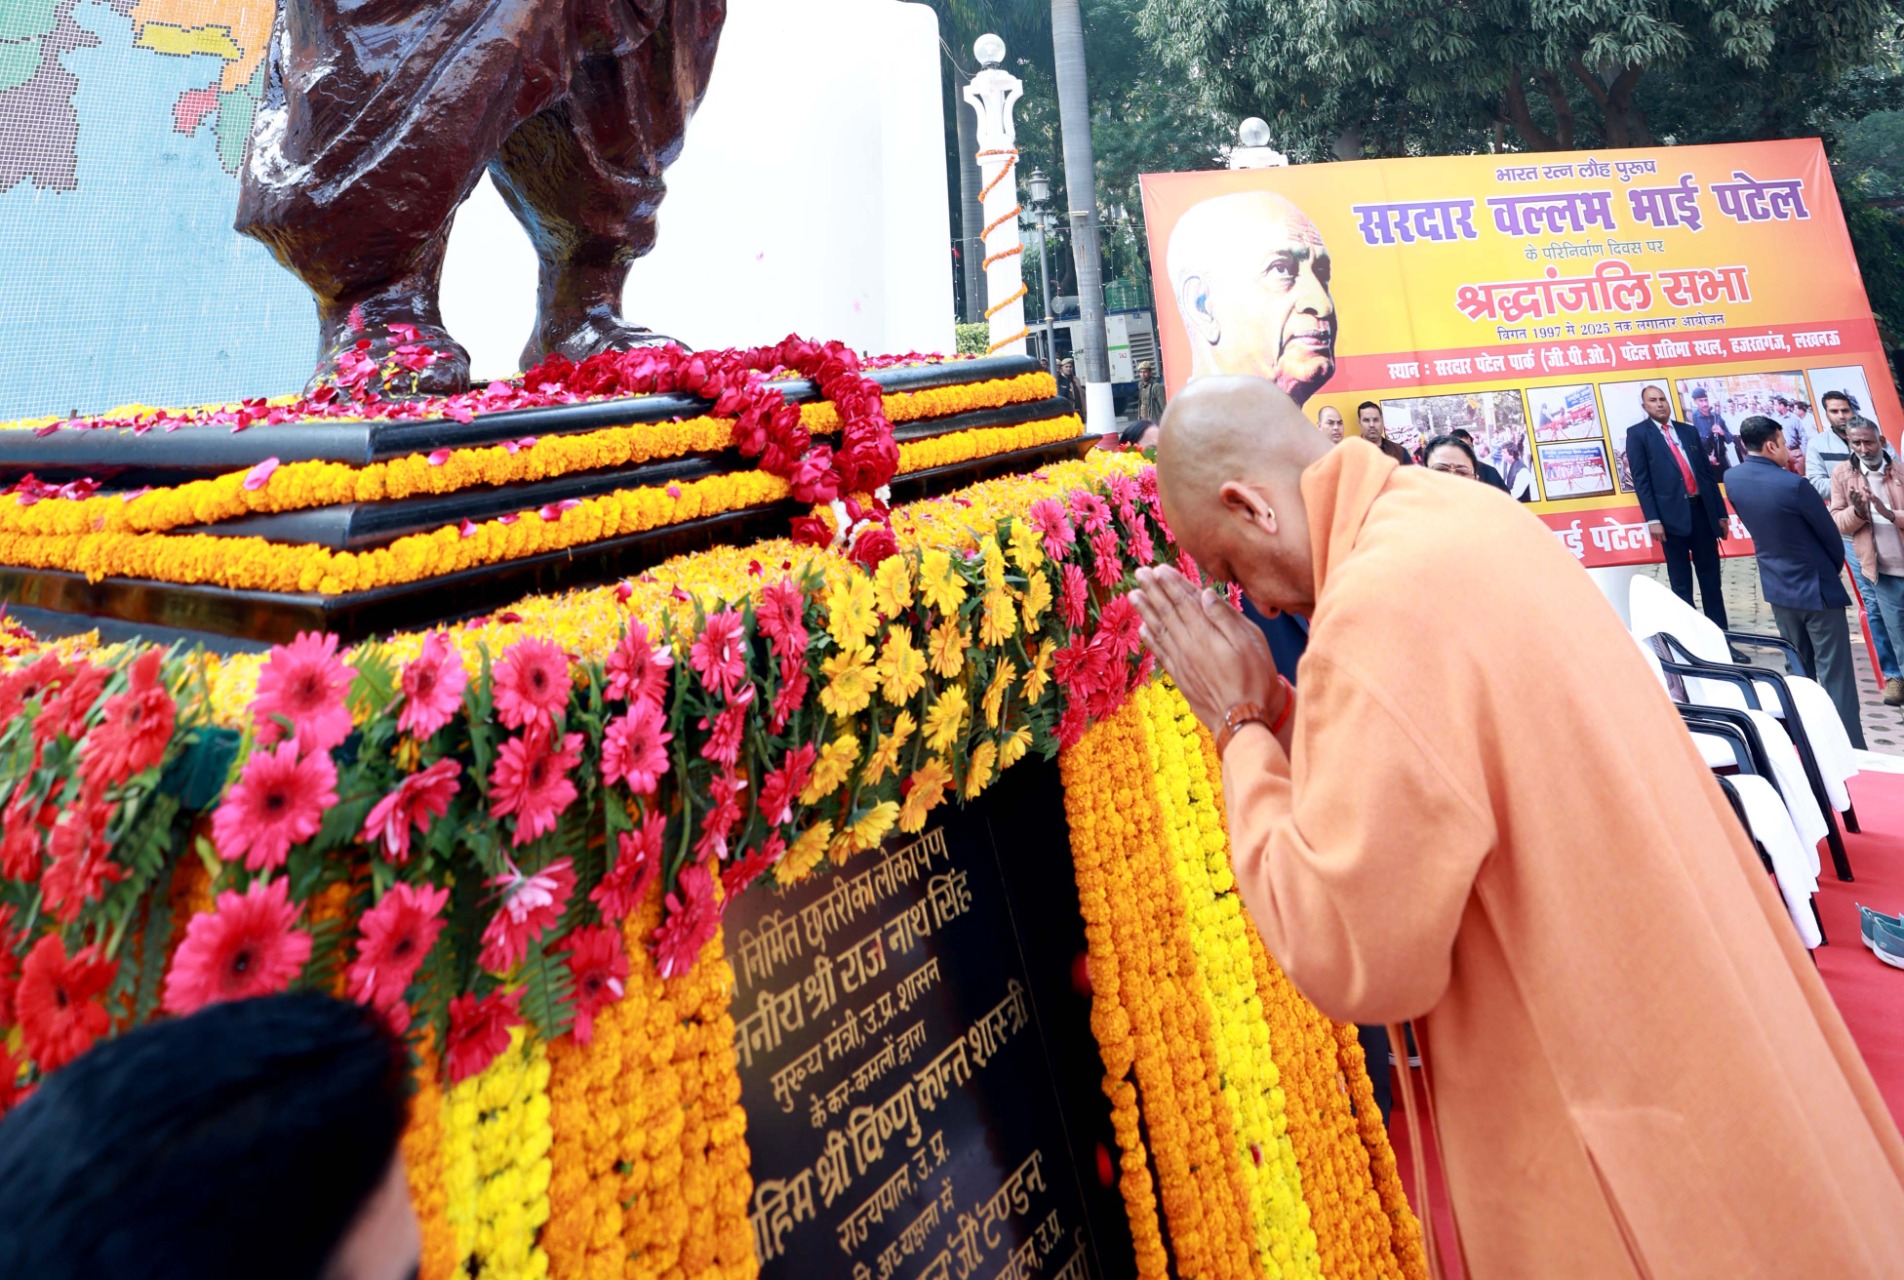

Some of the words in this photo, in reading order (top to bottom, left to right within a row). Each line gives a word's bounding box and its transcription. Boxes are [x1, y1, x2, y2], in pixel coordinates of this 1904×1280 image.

[1496, 167, 1538, 181] भारत
[1543, 164, 1573, 179] रत्न
[1578, 158, 1611, 178] लौह
[1353, 200, 1478, 244] सरदार
[1487, 191, 1616, 235] वल्लभ
[1628, 175, 1702, 232] भाई
[1711, 173, 1809, 222] पटेल
[1524, 244, 1538, 260] के
[1541, 239, 1604, 260] परिनिर्वाण
[1606, 239, 1642, 256] दिवस
[1645, 240, 1665, 253] पर
[1457, 260, 1651, 322] श्रद्धांजलि
[1659, 267, 1751, 307] सभा
[1386, 361, 1421, 380] स्थान
[1433, 357, 1472, 376] सरदार
[1474, 352, 1506, 373] पटेल
[1507, 349, 1535, 370] पार्क
[1619, 341, 1651, 362] पटेल
[1653, 338, 1691, 360] प्रतिमा
[1728, 331, 1791, 353] हजरतगंज,
[1792, 329, 1841, 349] लखनऊ
[1497, 326, 1527, 340] विगत
[1533, 326, 1561, 338] 1997
[1566, 322, 1576, 335] से
[1581, 322, 1611, 336] 2025
[1615, 320, 1633, 332] तक
[1637, 317, 1678, 329] लगातार
[1681, 311, 1725, 326] आयोजन
[1589, 516, 1653, 552] पटेल
[737, 908, 803, 990] निर्मित
[799, 875, 855, 953] छतरी
[848, 869, 877, 915] का
[872, 825, 950, 900] लोकार्पण
[803, 954, 838, 1020] श्री
[837, 927, 888, 993] राज
[884, 898, 932, 956] नाथ
[928, 867, 973, 929] सिंह
[769, 1042, 825, 1114] मुख्य
[808, 1092, 828, 1129] के
[895, 1019, 928, 1066] द्वारा
[815, 1127, 853, 1209] श्री
[845, 1081, 923, 1176] विष्णु
[912, 1034, 973, 1112] कान्त
[967, 977, 1030, 1068] शास्त्री
[938, 1175, 956, 1213] में
[974, 1148, 1048, 1250] टण्डन
